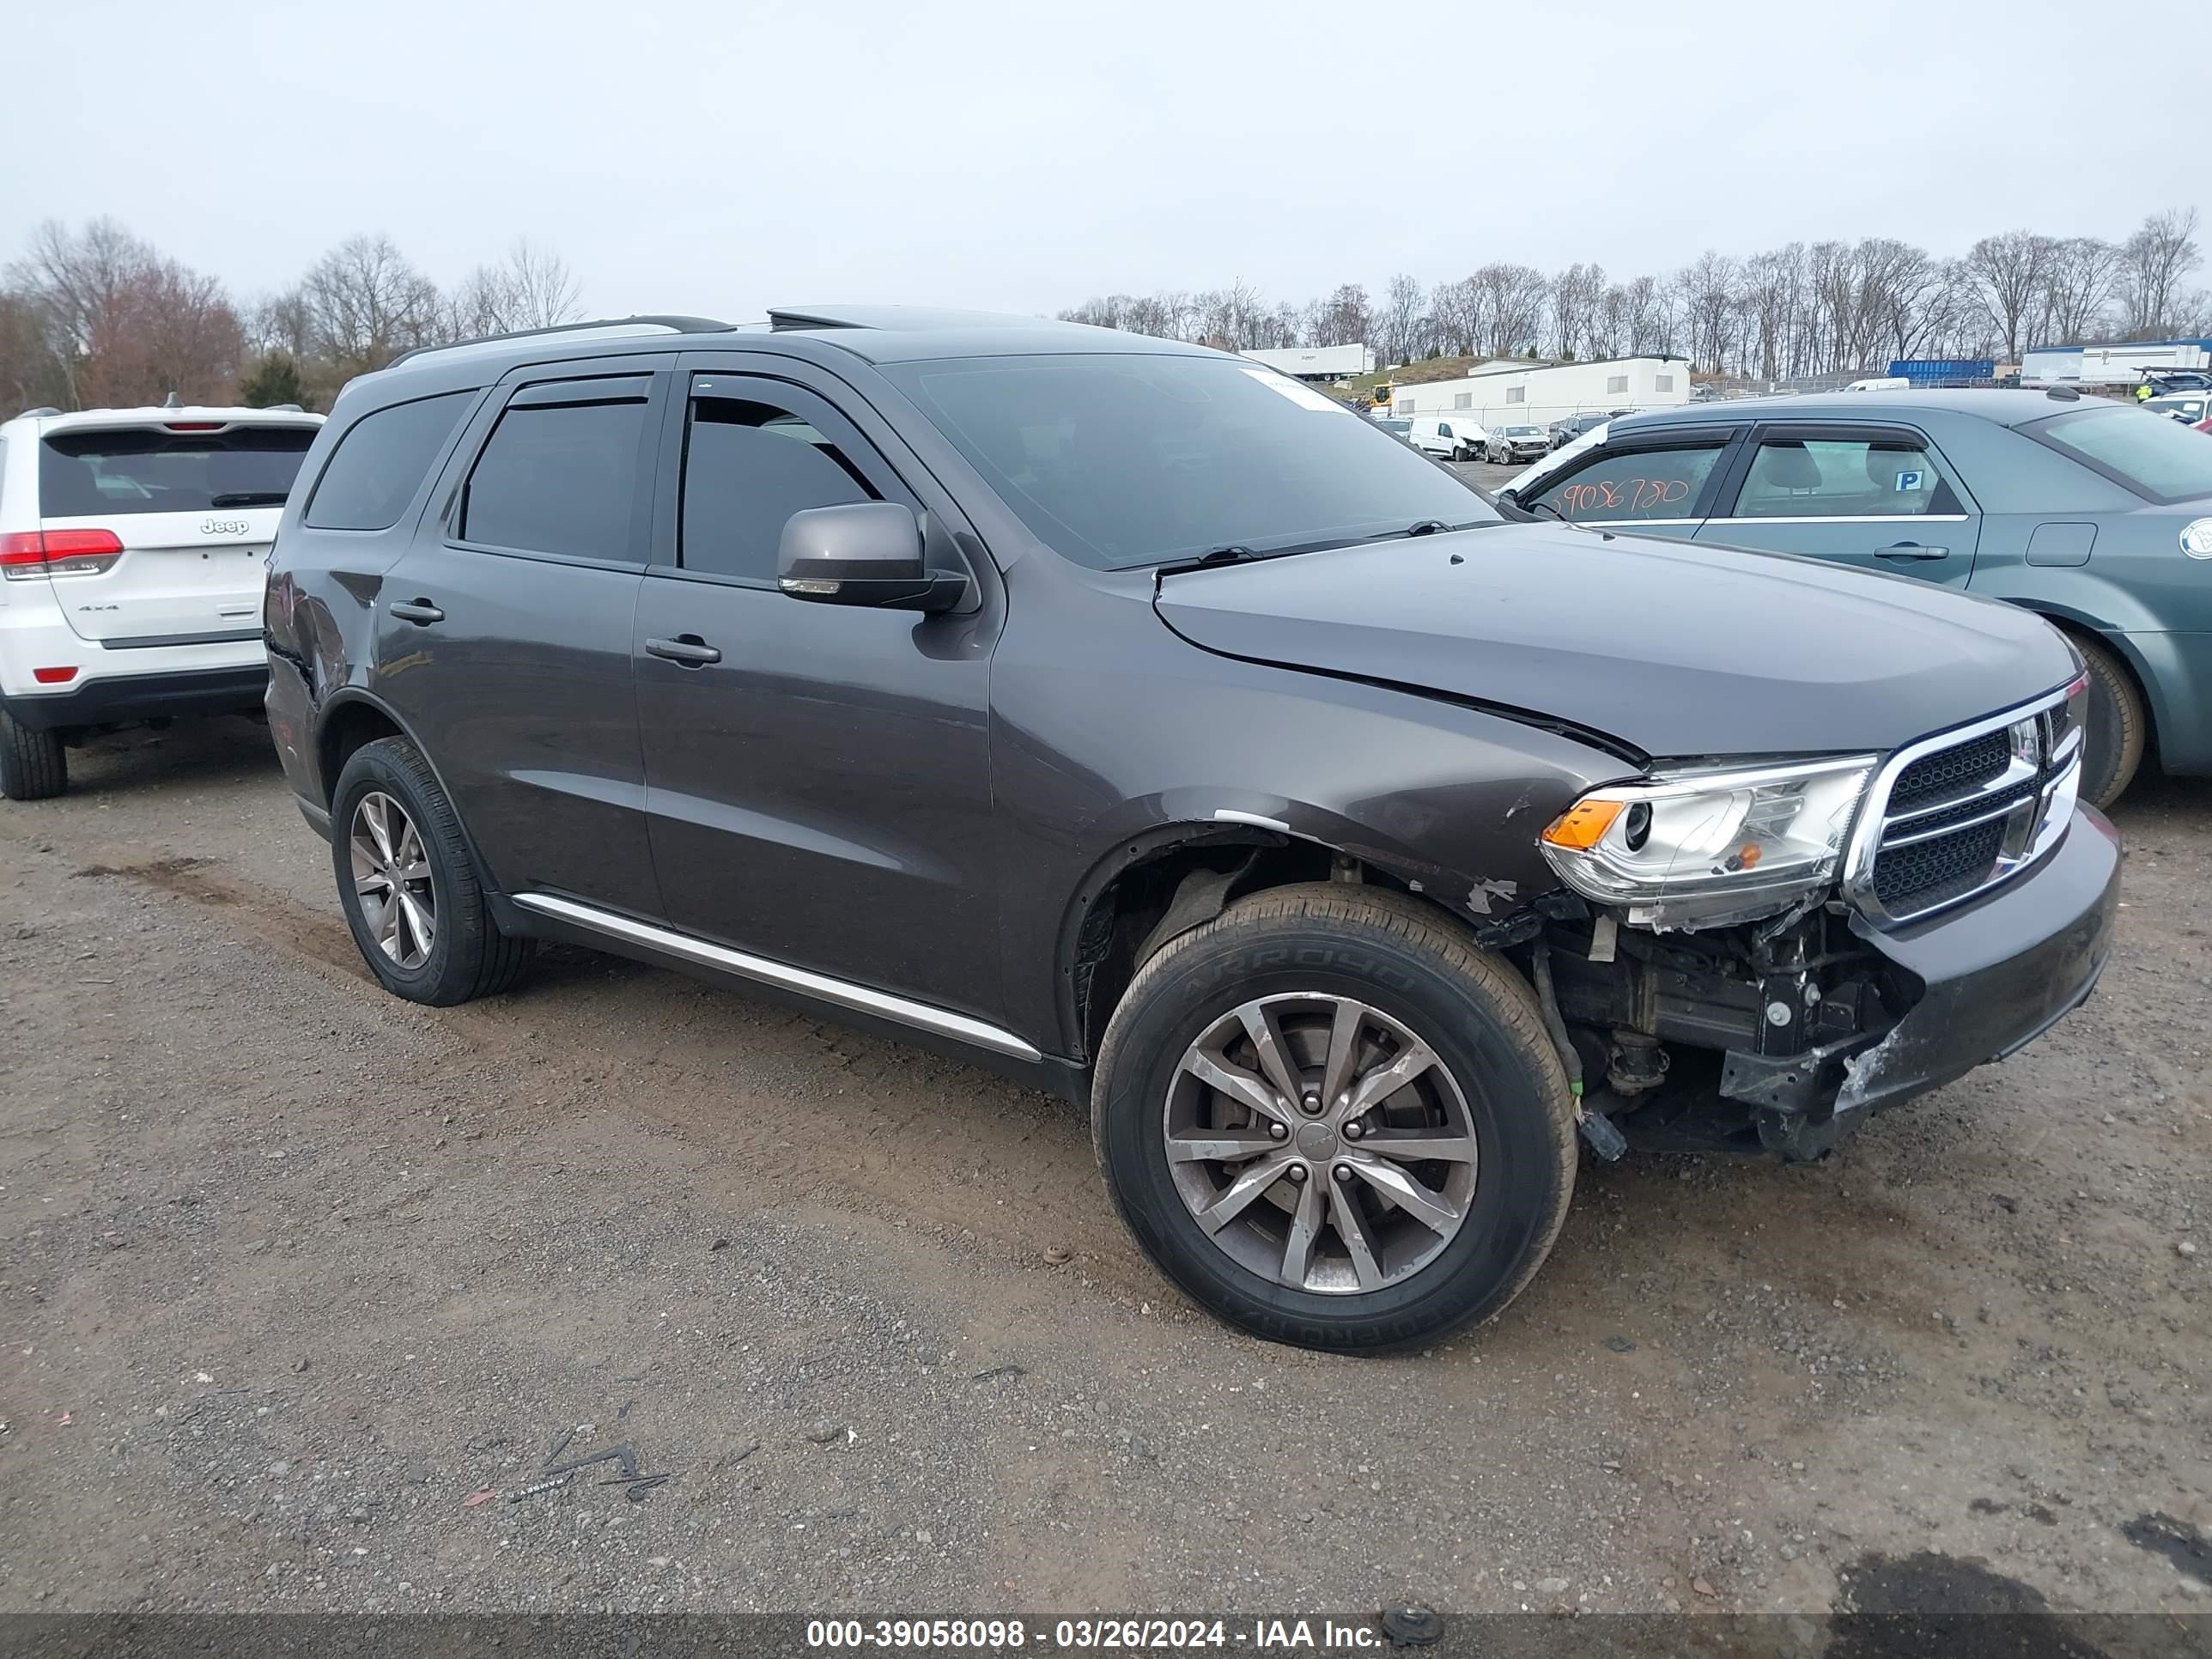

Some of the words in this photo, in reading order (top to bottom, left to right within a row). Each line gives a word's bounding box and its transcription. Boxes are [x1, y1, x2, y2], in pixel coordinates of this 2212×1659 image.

[1900, 472, 1918, 490] P
[200, 519, 249, 536] Jeep
[1182, 947, 1416, 1001] ARROYO
